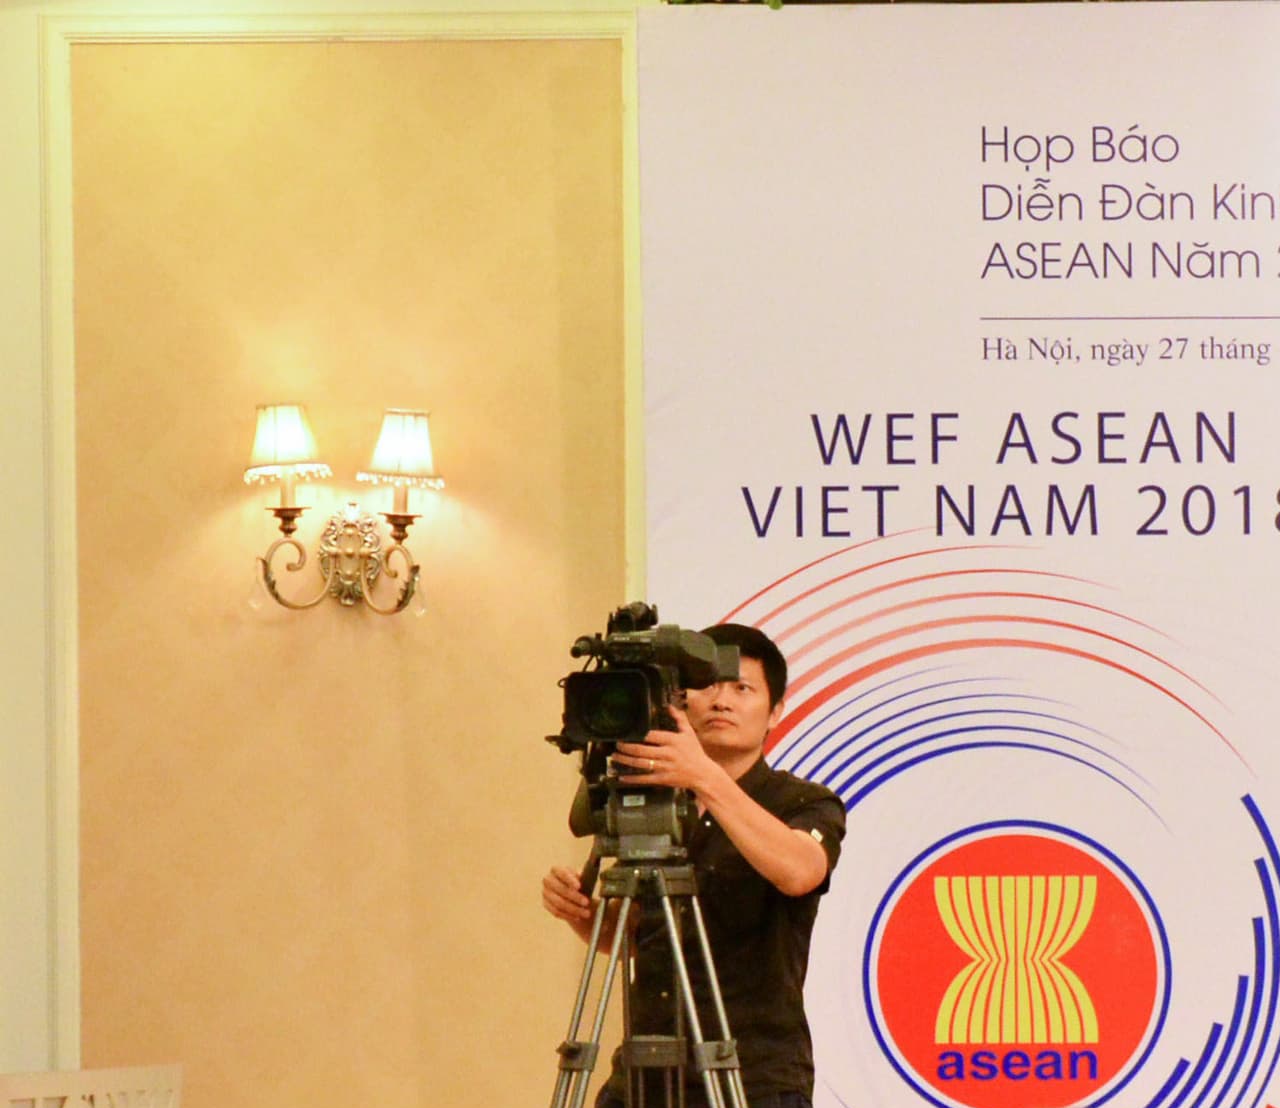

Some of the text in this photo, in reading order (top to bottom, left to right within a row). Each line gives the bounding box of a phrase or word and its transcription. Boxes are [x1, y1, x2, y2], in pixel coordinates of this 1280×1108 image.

[981, 124, 1179, 172] Họp Báo
[982, 175, 1083, 222] Diễn
[1098, 180, 1194, 221] Đàn
[980, 240, 1133, 280] ASEAN
[1151, 240, 1261, 279] Năm
[981, 336, 1019, 361] Hà
[1027, 336, 1081, 367] Nội,
[1089, 337, 1150, 367] ngày
[1157, 336, 1190, 361] 27
[1199, 335, 1271, 367] tháng
[809, 410, 1237, 466] WEF ASEAN
[741, 485, 900, 538] VIET
[936, 484, 1099, 537] NAM
[936, 1050, 1098, 1080] asean
